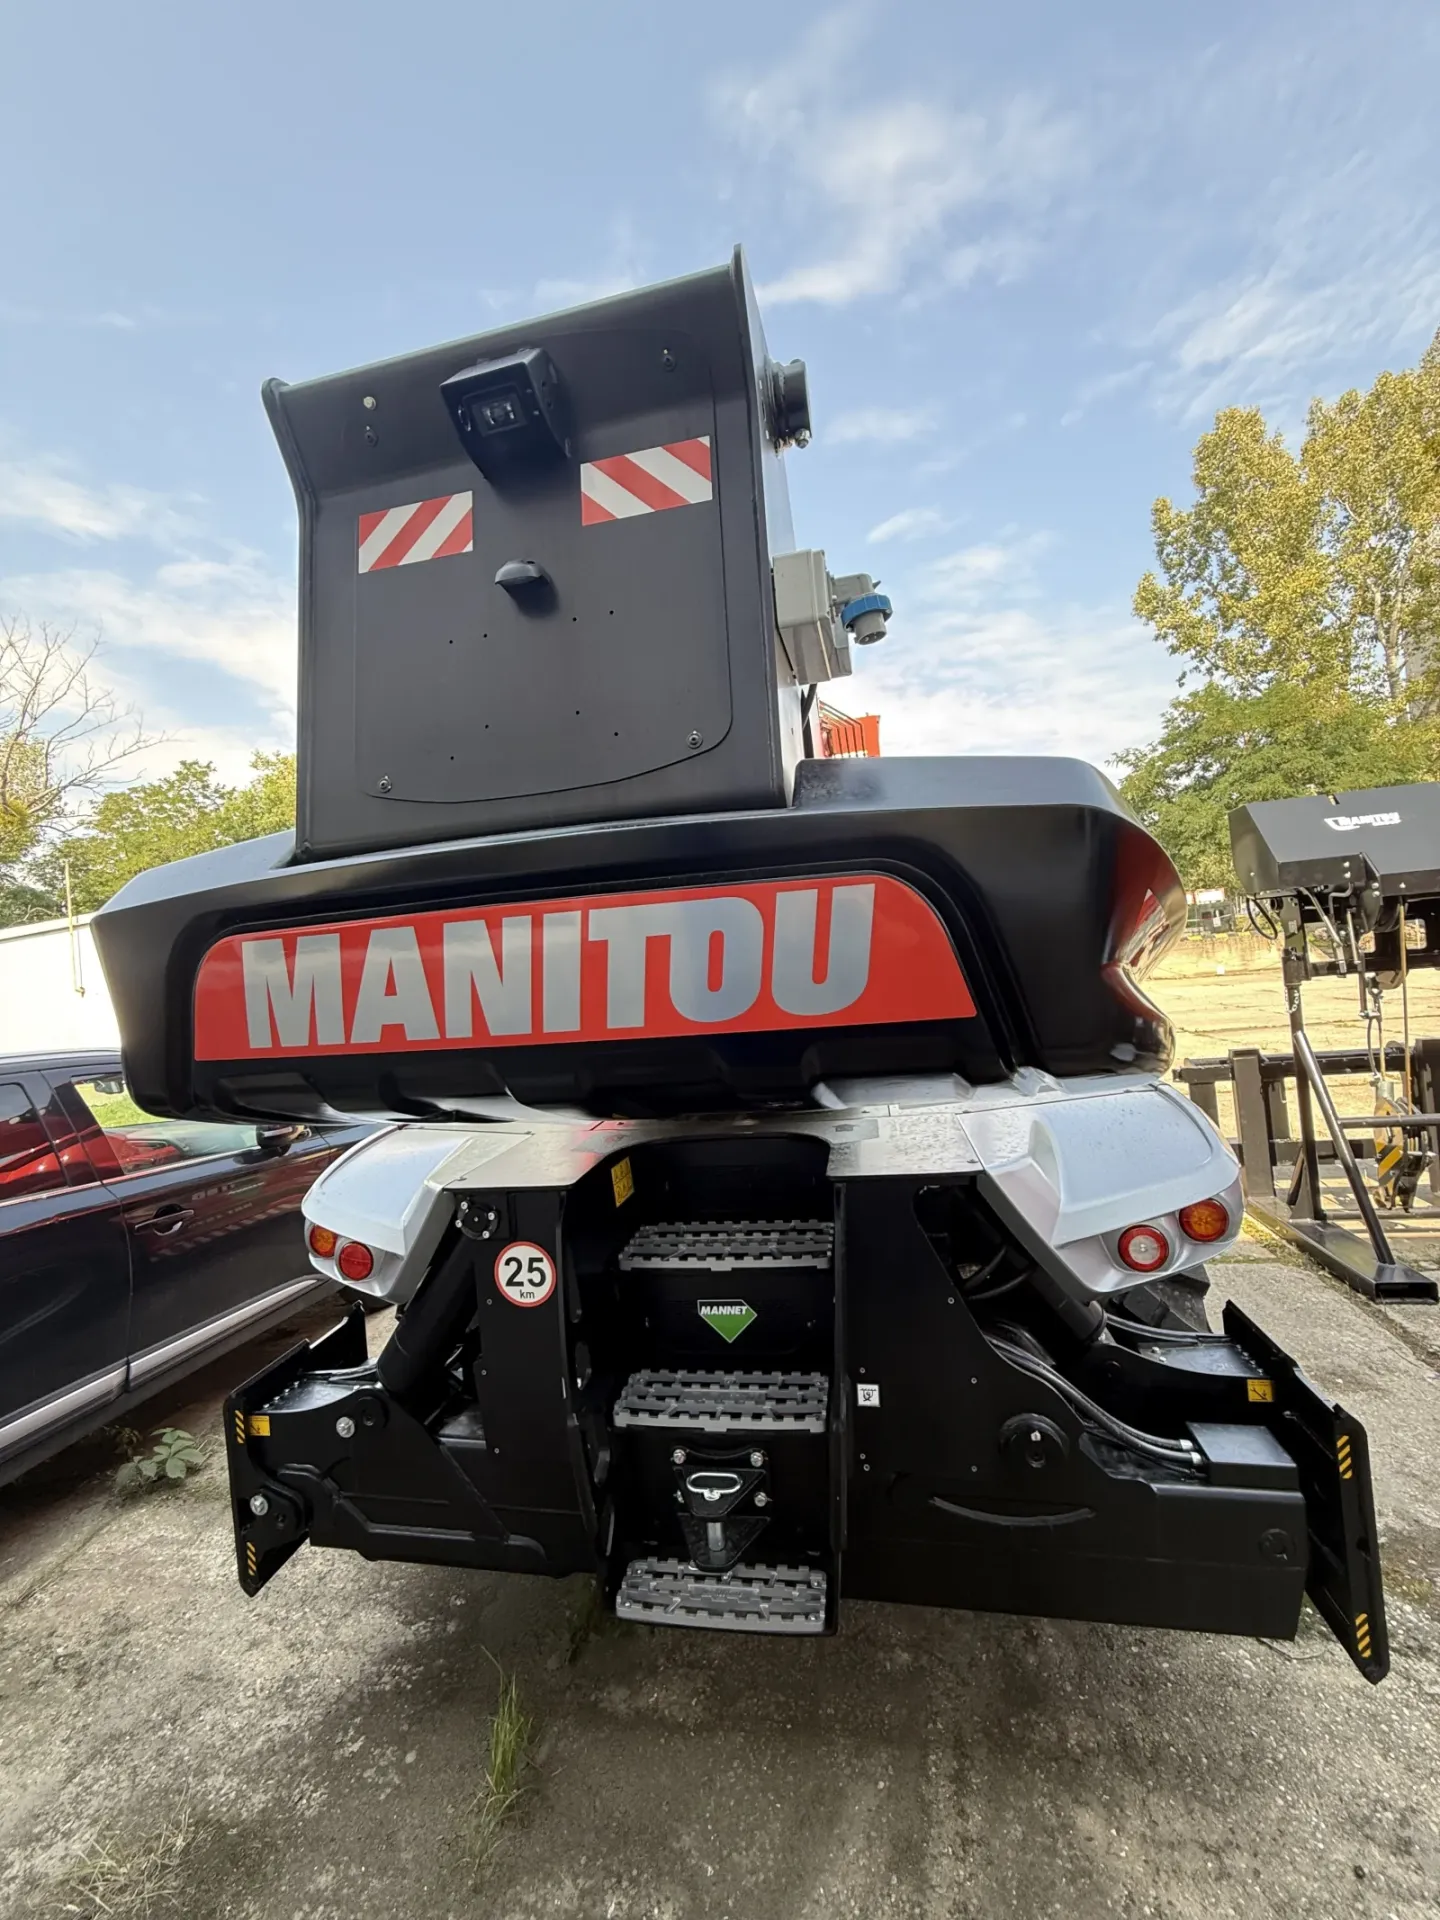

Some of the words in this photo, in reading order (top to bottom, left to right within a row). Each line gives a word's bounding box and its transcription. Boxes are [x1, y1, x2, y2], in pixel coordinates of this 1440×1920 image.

[242, 883, 876, 1049] MANITOU
[504, 1256, 546, 1288] 25
[519, 1289, 535, 1299] km
[700, 1305, 748, 1315] MANNET
